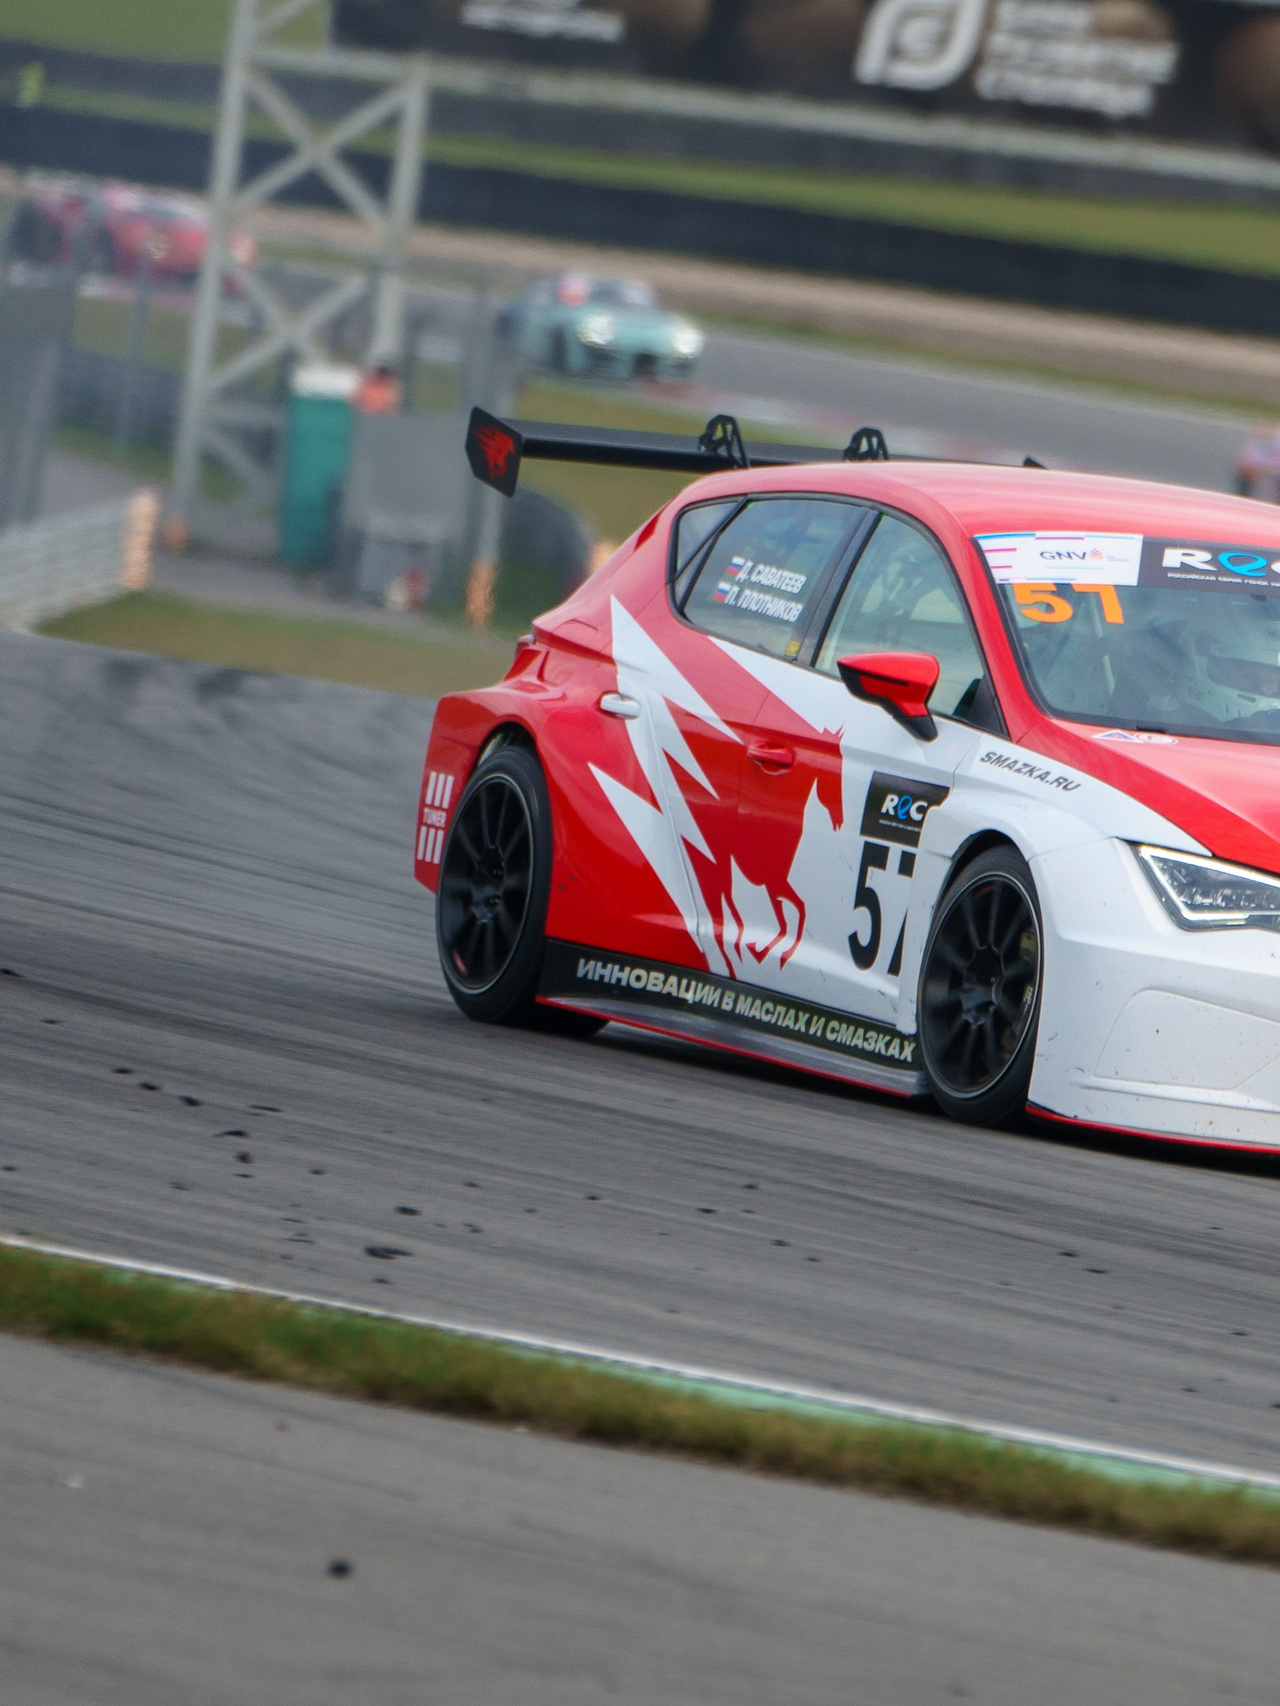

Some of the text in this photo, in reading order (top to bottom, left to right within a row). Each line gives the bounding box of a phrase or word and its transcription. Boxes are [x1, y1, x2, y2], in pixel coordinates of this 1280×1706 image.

[1039, 551, 1087, 560] GNV
[750, 564, 807, 594] САВАТЕЕВ
[724, 585, 803, 623] П. ПЛОТНИКОВ
[1013, 583, 1124, 624] 57
[979, 751, 1083, 792] SMAZKA.RU
[576, 958, 916, 1063] ИННОВАЦИИ В МАСЛАХ И СМАЗКАХ
